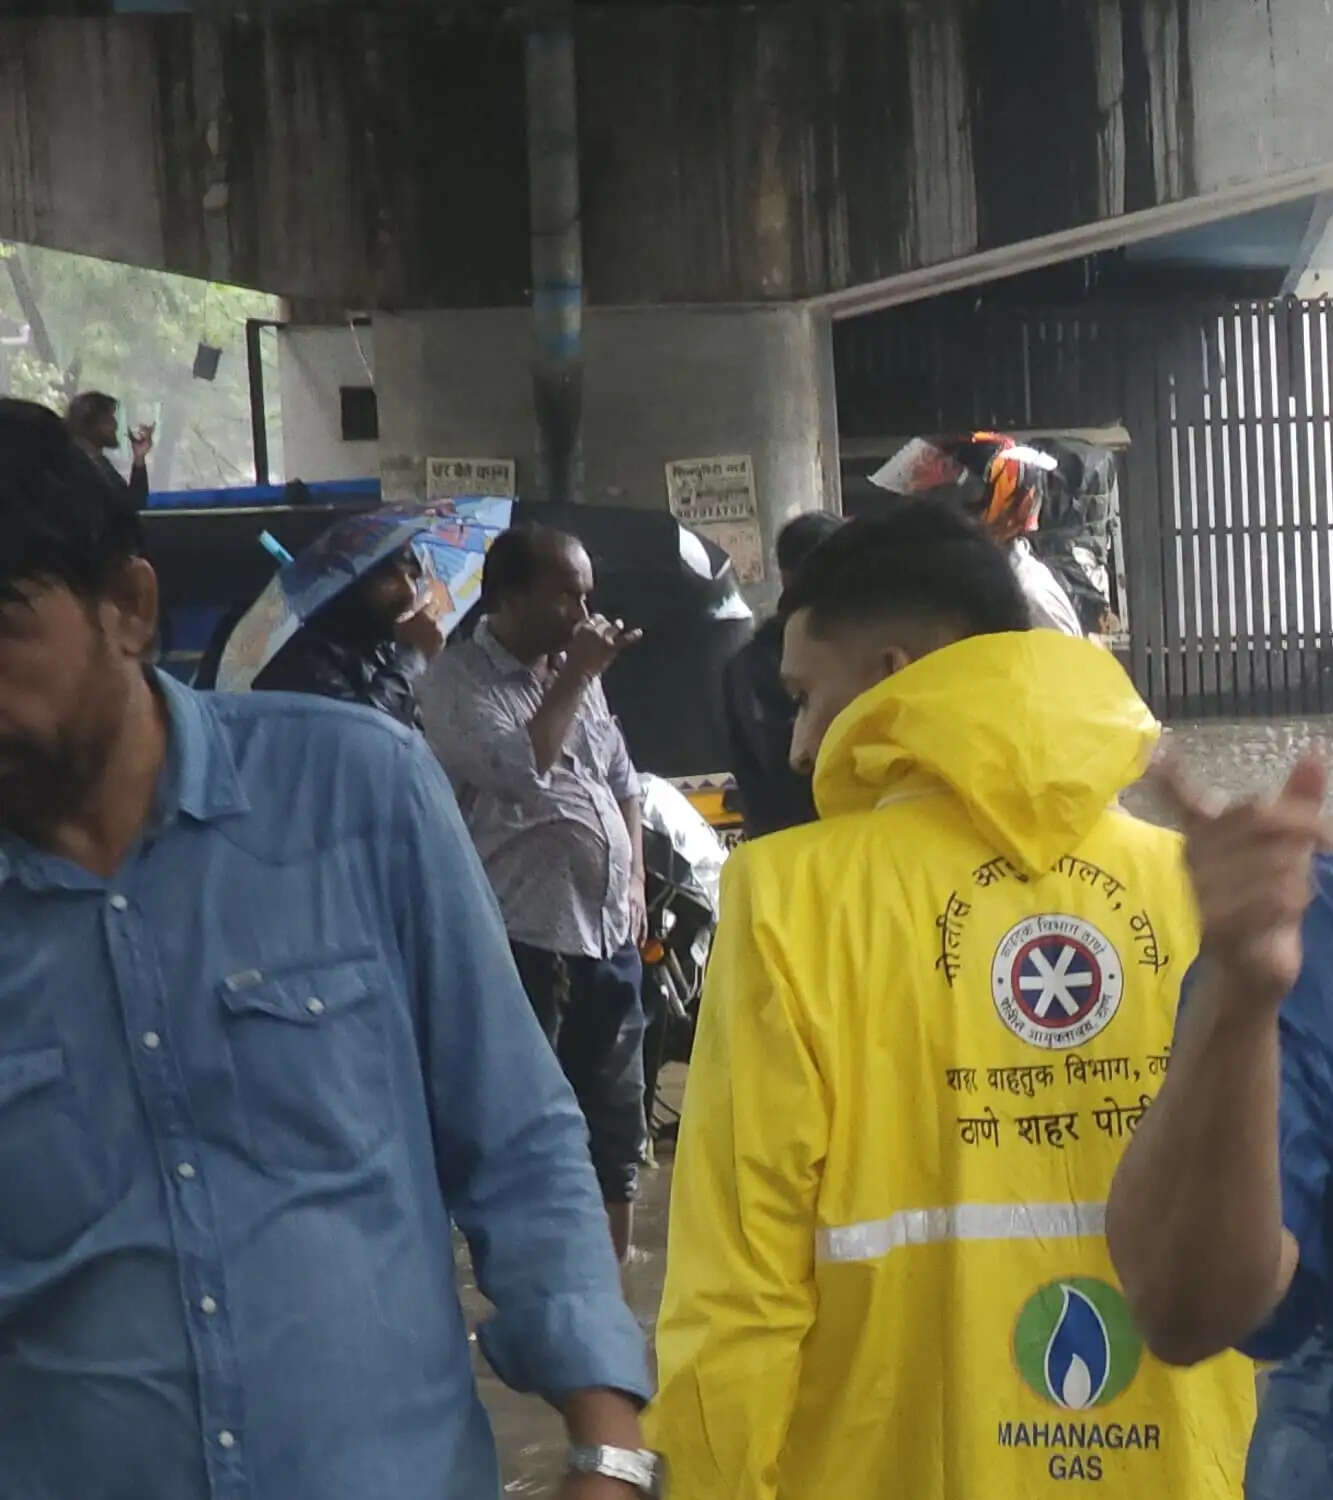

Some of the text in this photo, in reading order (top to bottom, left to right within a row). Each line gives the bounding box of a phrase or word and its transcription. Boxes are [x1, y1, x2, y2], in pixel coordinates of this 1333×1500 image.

[986, 1064, 1054, 1098] वाहतुक
[956, 1105, 1000, 1149] ठाणे
[1014, 1111, 1080, 1149] शहर
[998, 1421, 1161, 1450] MAHANAGAR
[1048, 1453, 1104, 1481] GAS
